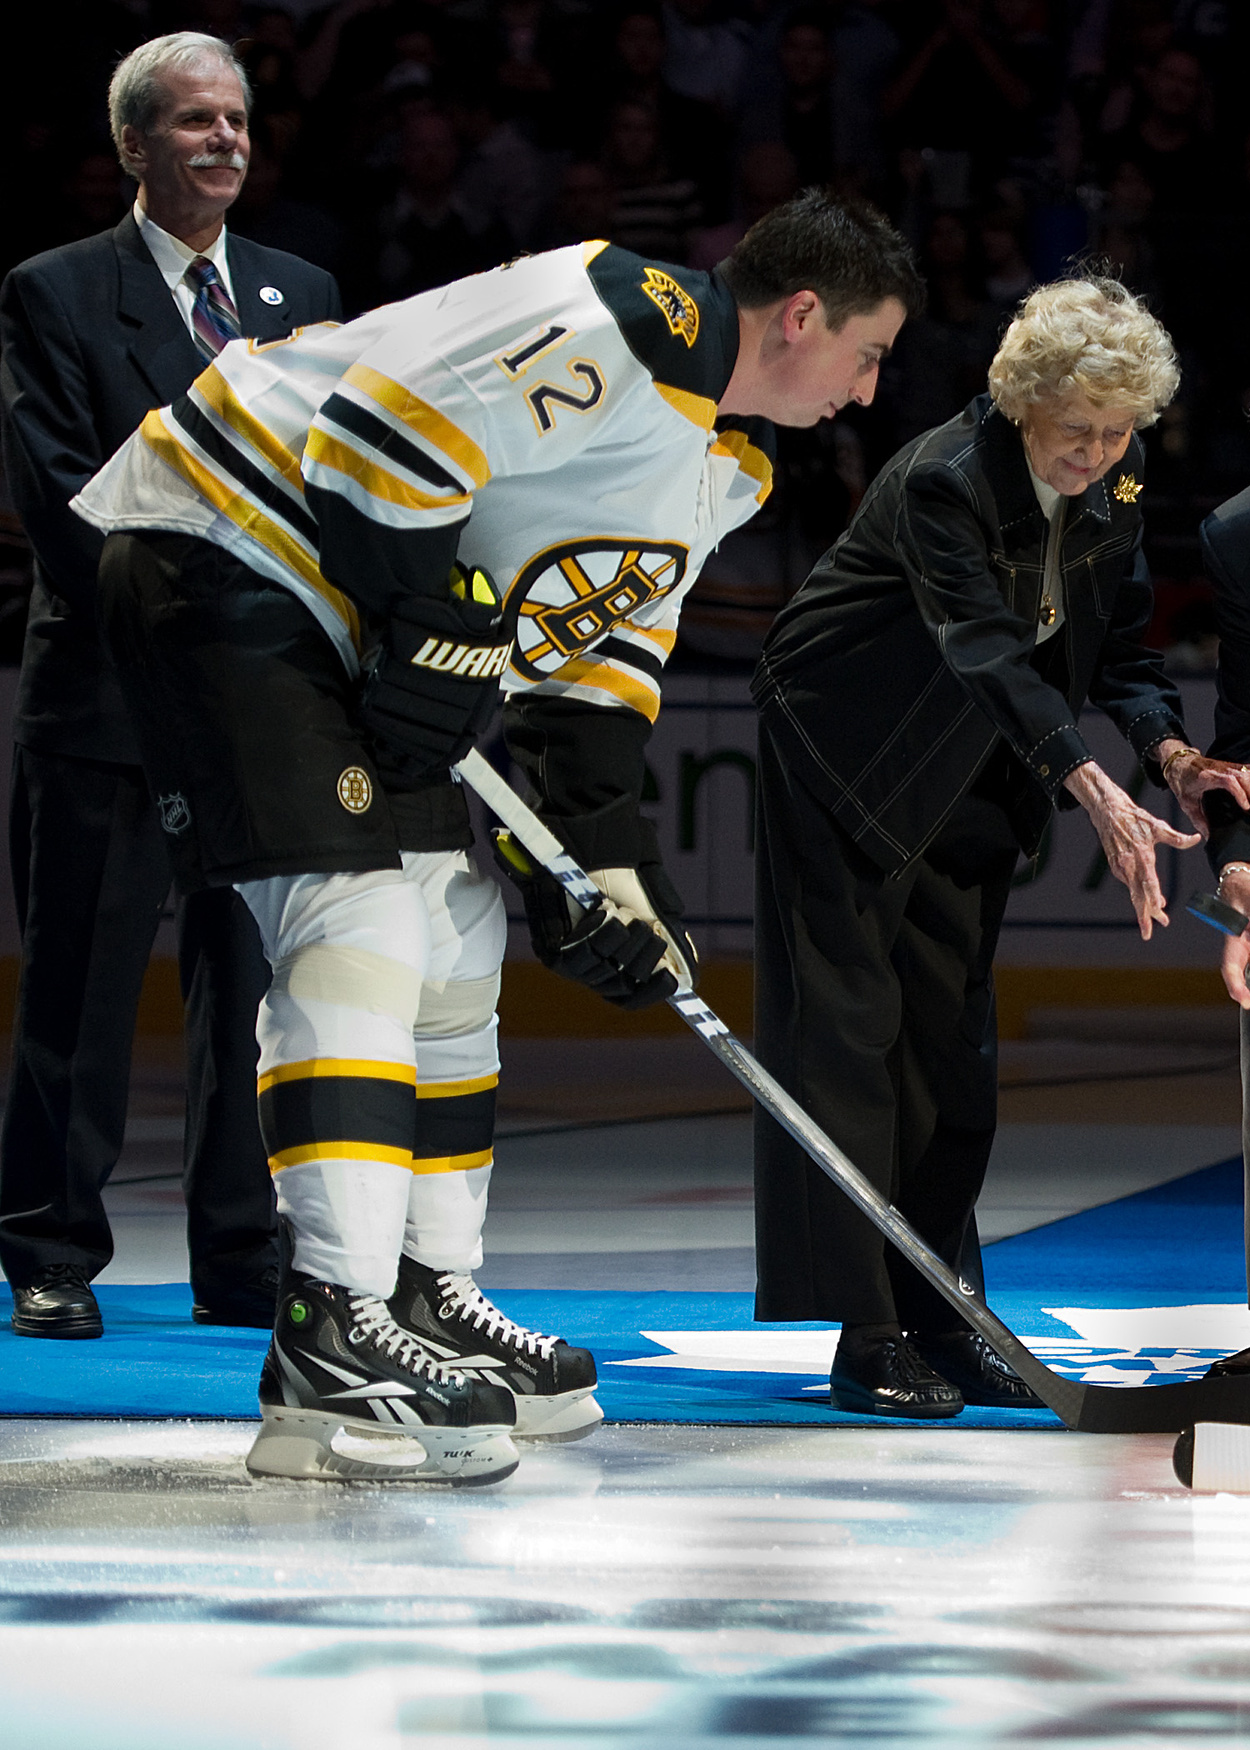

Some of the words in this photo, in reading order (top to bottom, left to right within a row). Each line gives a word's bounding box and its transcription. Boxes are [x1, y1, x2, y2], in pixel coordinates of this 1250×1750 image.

[494, 319, 607, 438] 12
[410, 638, 515, 677] WAR
[514, 1356, 539, 1377] Reebok
